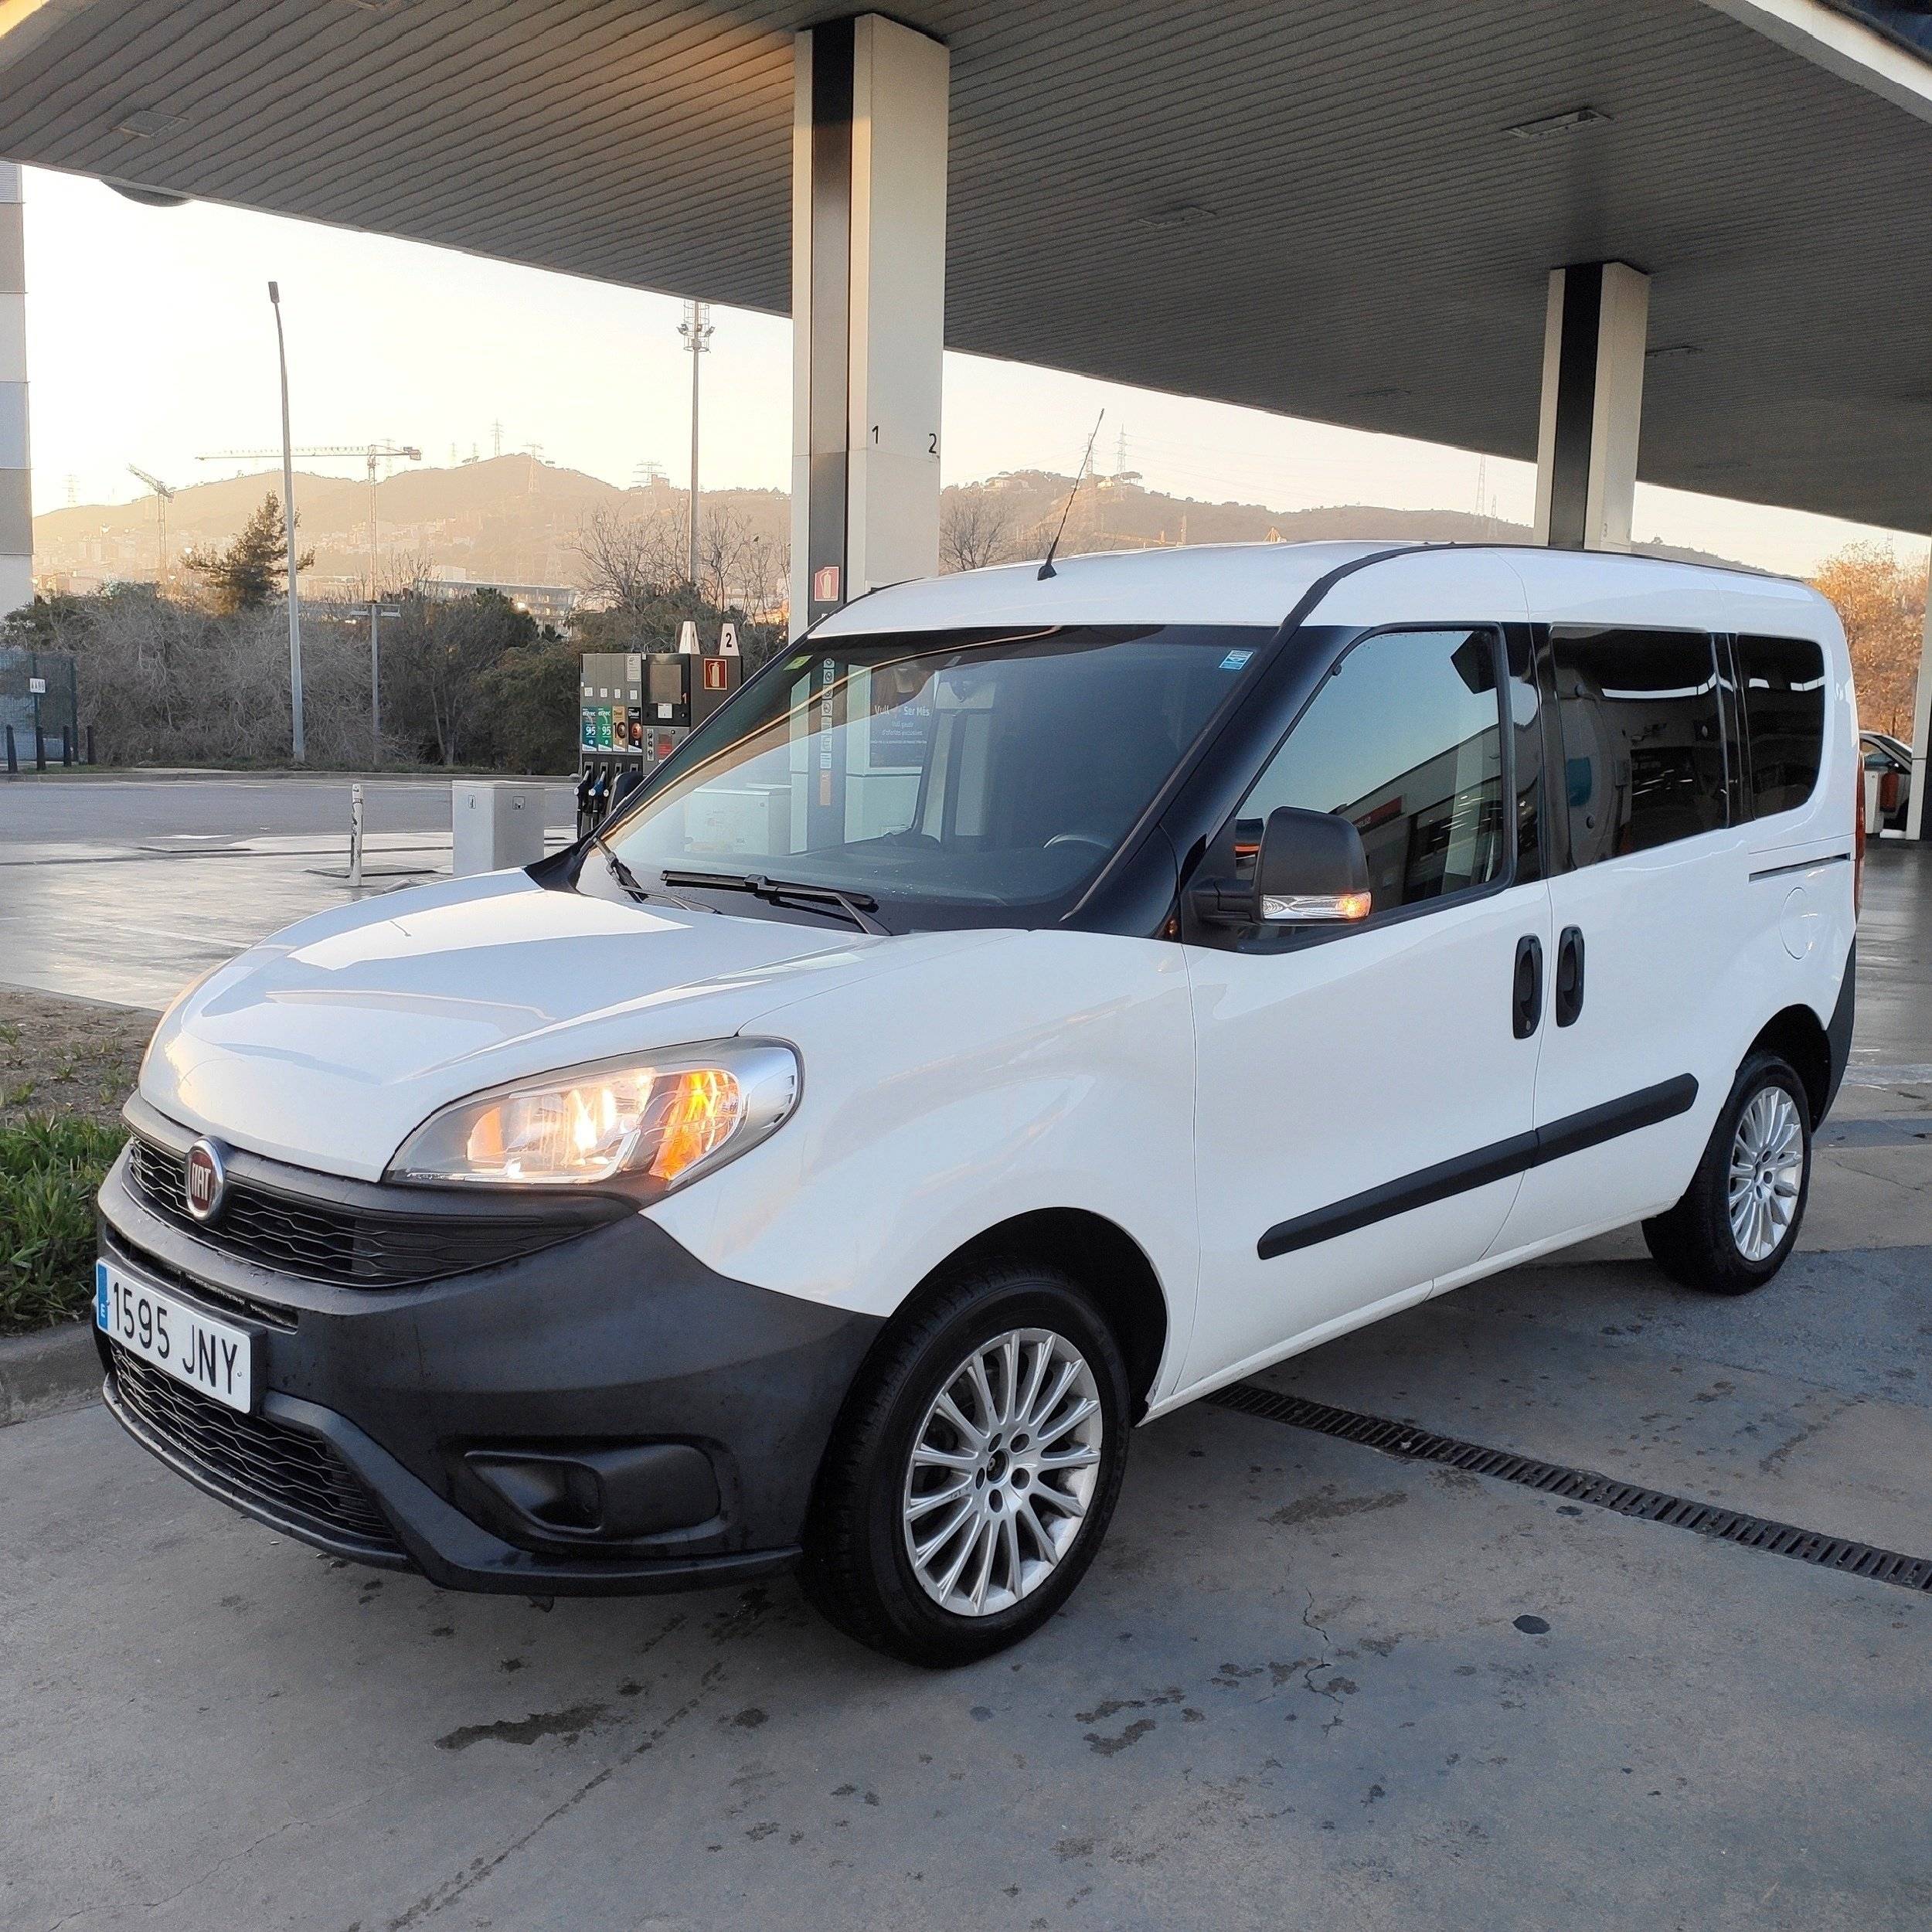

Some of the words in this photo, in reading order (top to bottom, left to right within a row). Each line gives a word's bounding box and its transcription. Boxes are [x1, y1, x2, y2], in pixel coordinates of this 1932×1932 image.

[872, 425, 879, 444] 1
[928, 433, 937, 454] 2
[726, 632, 733, 648] 2
[586, 726, 596, 736] 95
[602, 726, 611, 736] 95
[192, 1162, 212, 1200] FIAT
[114, 1282, 170, 1359] 1595
[182, 1324, 238, 1395] JNY
